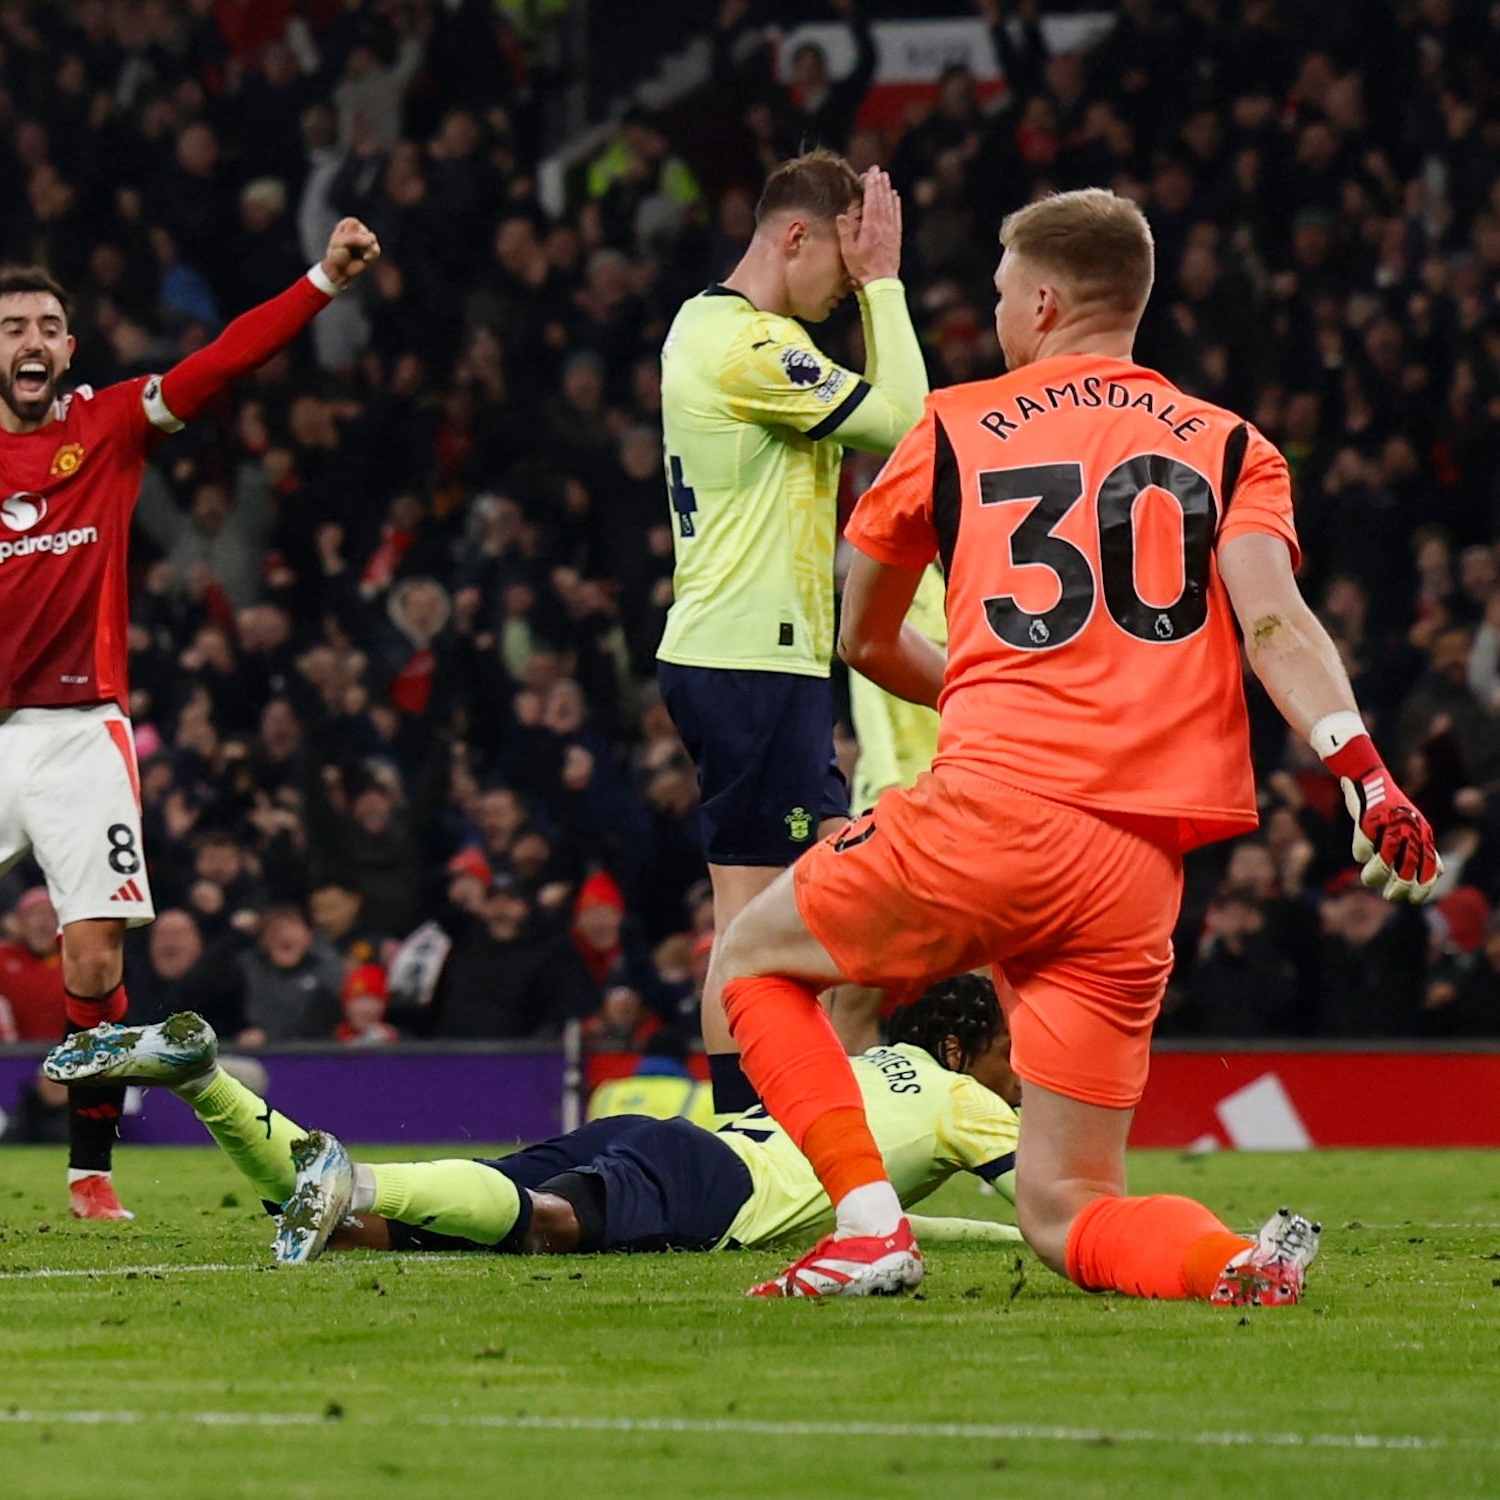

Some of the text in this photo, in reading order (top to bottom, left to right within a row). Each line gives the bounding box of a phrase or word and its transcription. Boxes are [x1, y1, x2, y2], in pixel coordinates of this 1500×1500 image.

[979, 377, 1206, 442] RAMSDALE
[978, 453, 1220, 652] 30
[107, 823, 140, 875] 8
